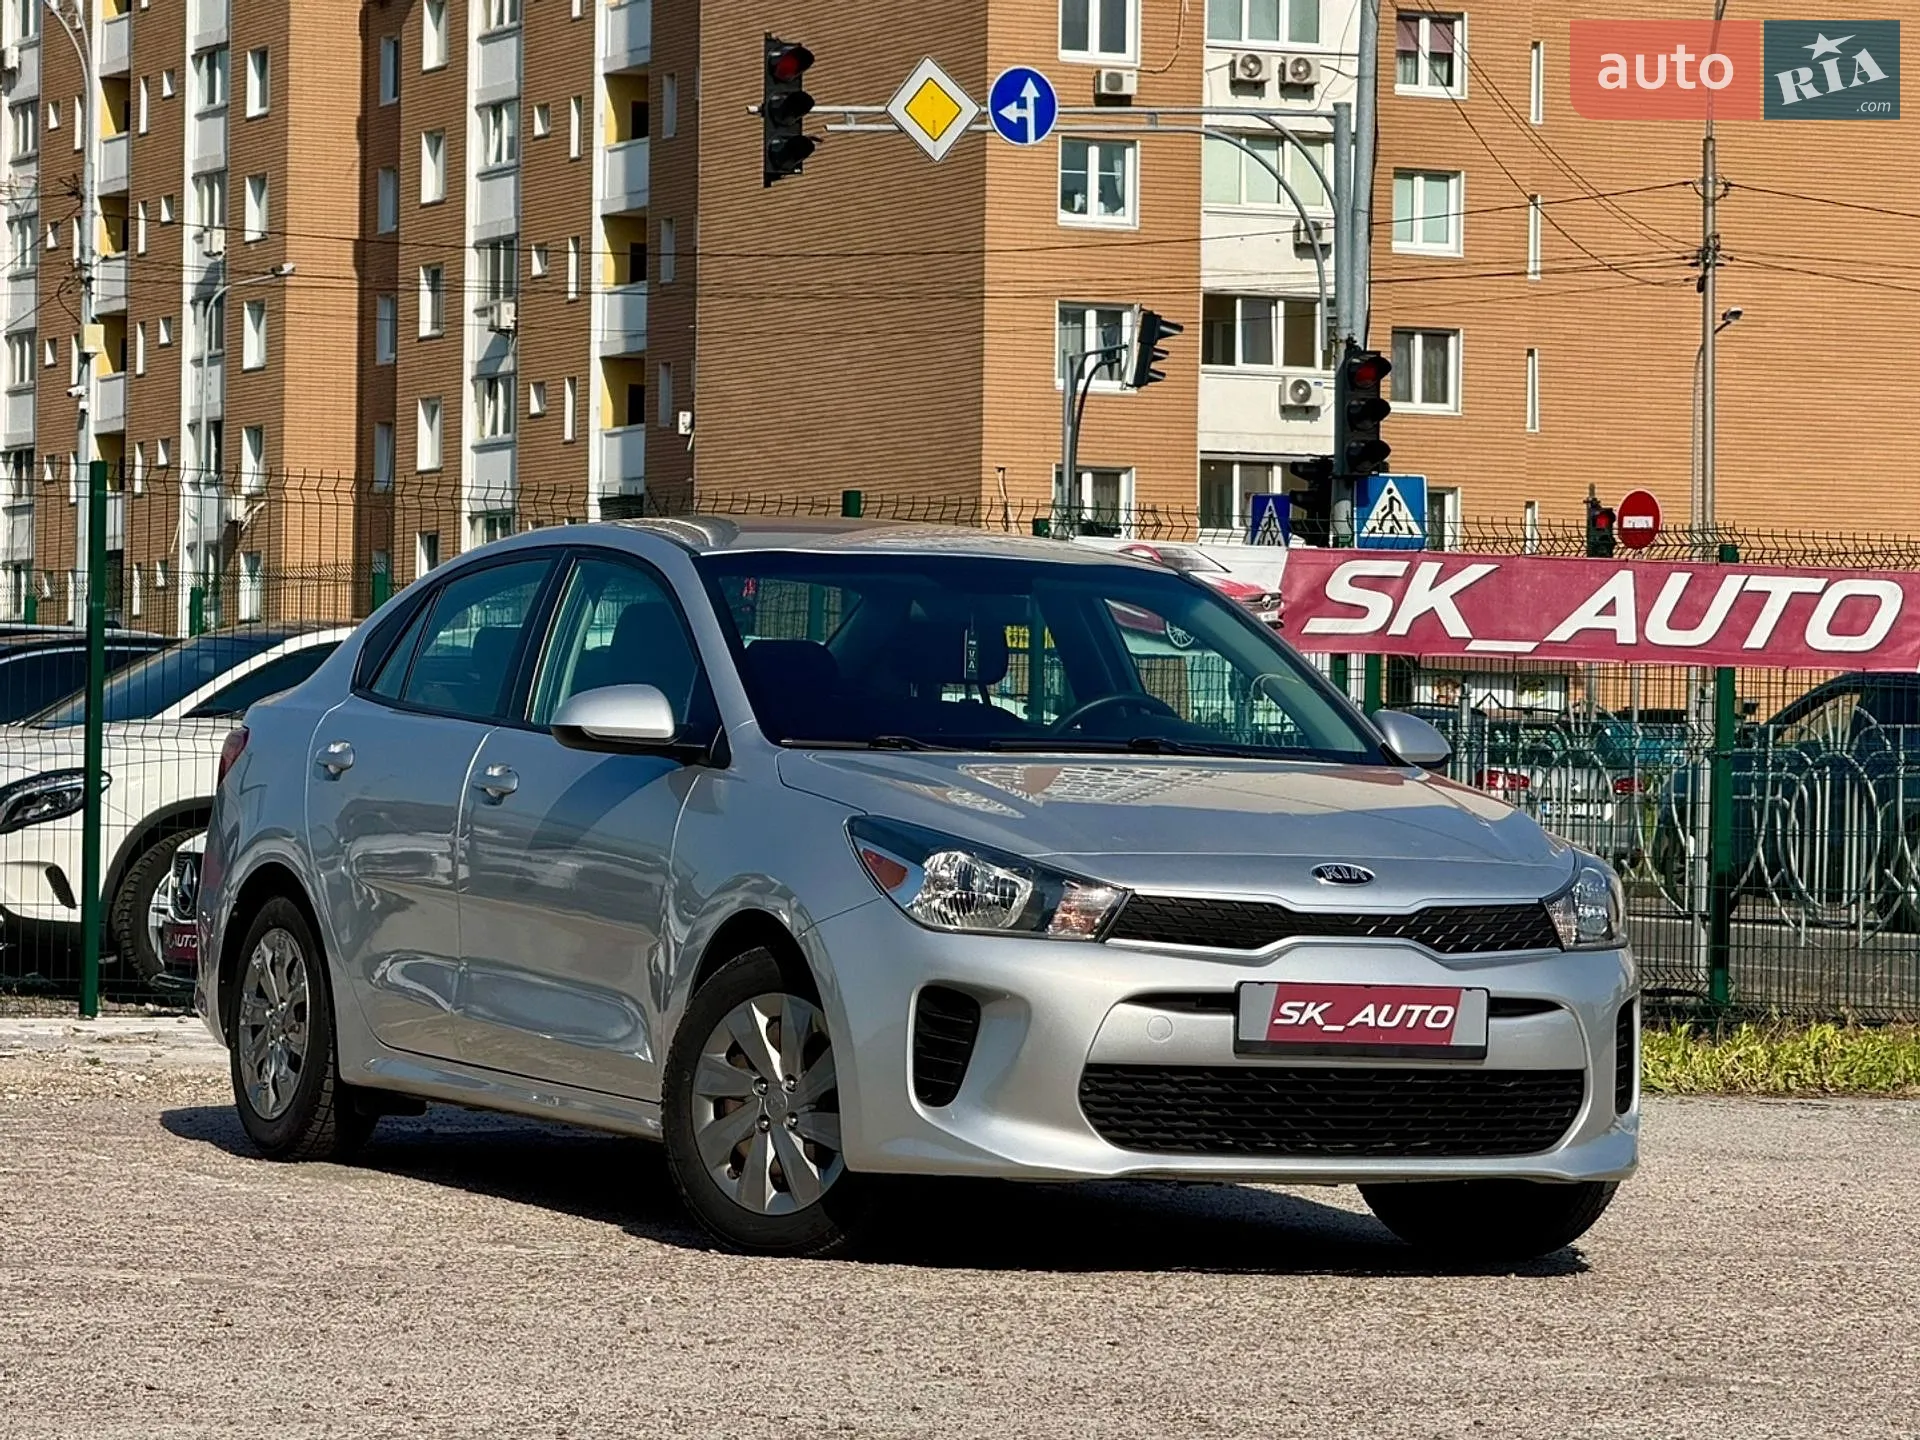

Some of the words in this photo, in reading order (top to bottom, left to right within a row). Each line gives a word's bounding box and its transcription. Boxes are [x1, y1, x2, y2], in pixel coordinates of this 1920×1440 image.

[1301, 559, 1905, 653] SK_AUTO
[1320, 865, 1368, 881] KIA
[1273, 1001, 1455, 1032] SK_AUTO
